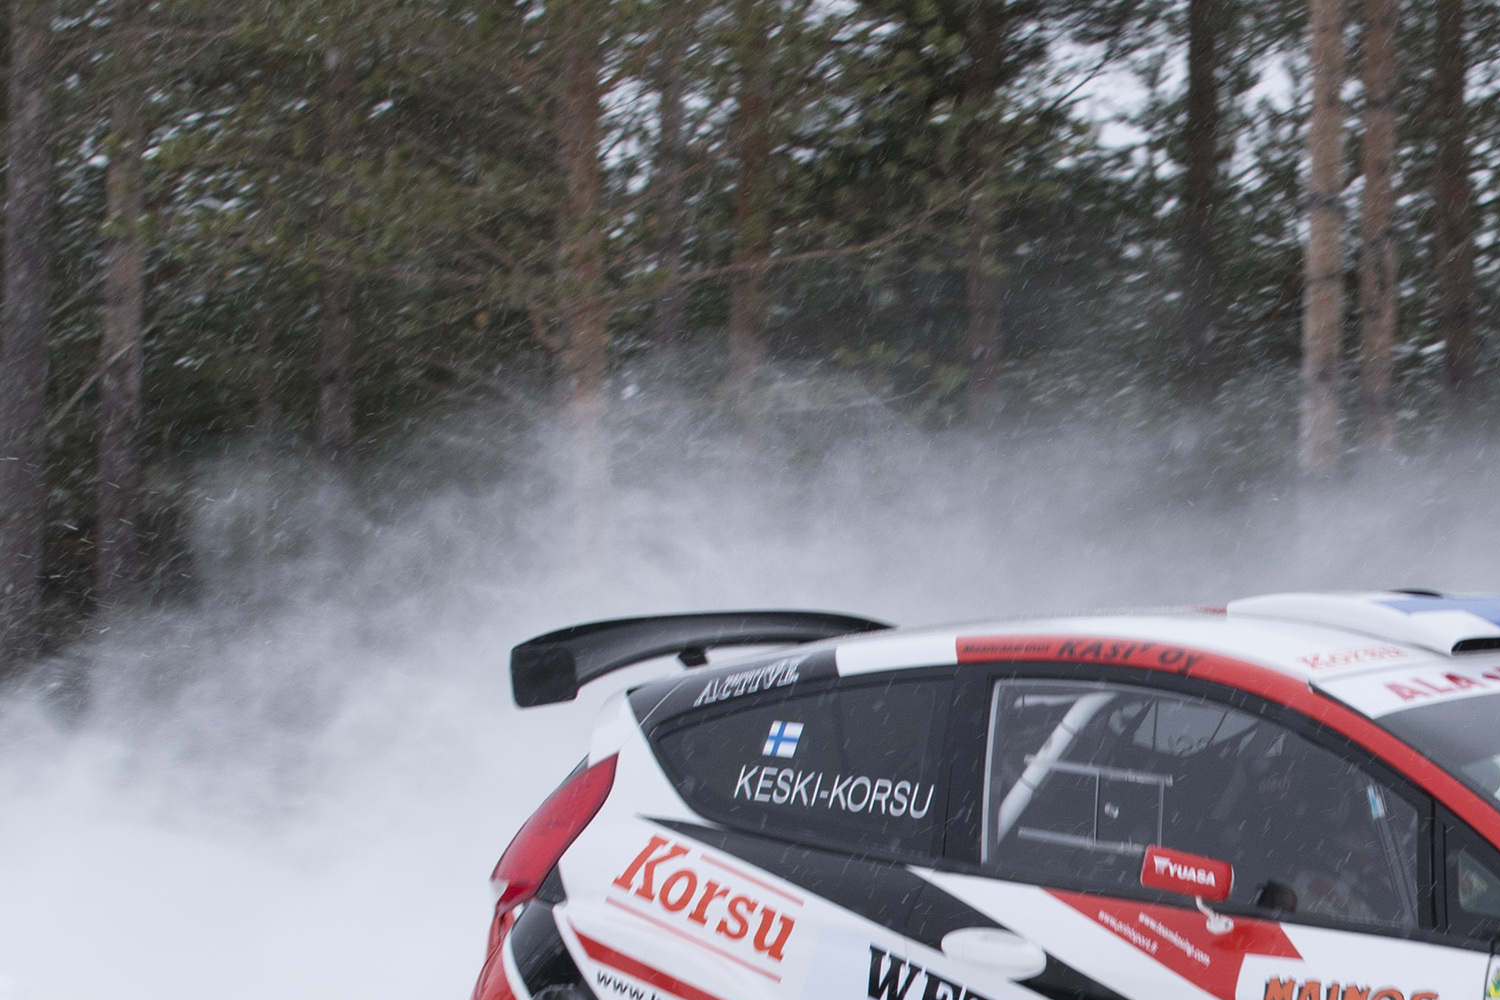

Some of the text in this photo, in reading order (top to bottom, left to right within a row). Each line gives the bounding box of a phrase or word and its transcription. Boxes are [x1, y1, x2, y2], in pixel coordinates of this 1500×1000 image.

[733, 764, 935, 819] KESKI-KORSU
[611, 832, 797, 963] Korsu
[1168, 863, 1216, 888] YUASA
